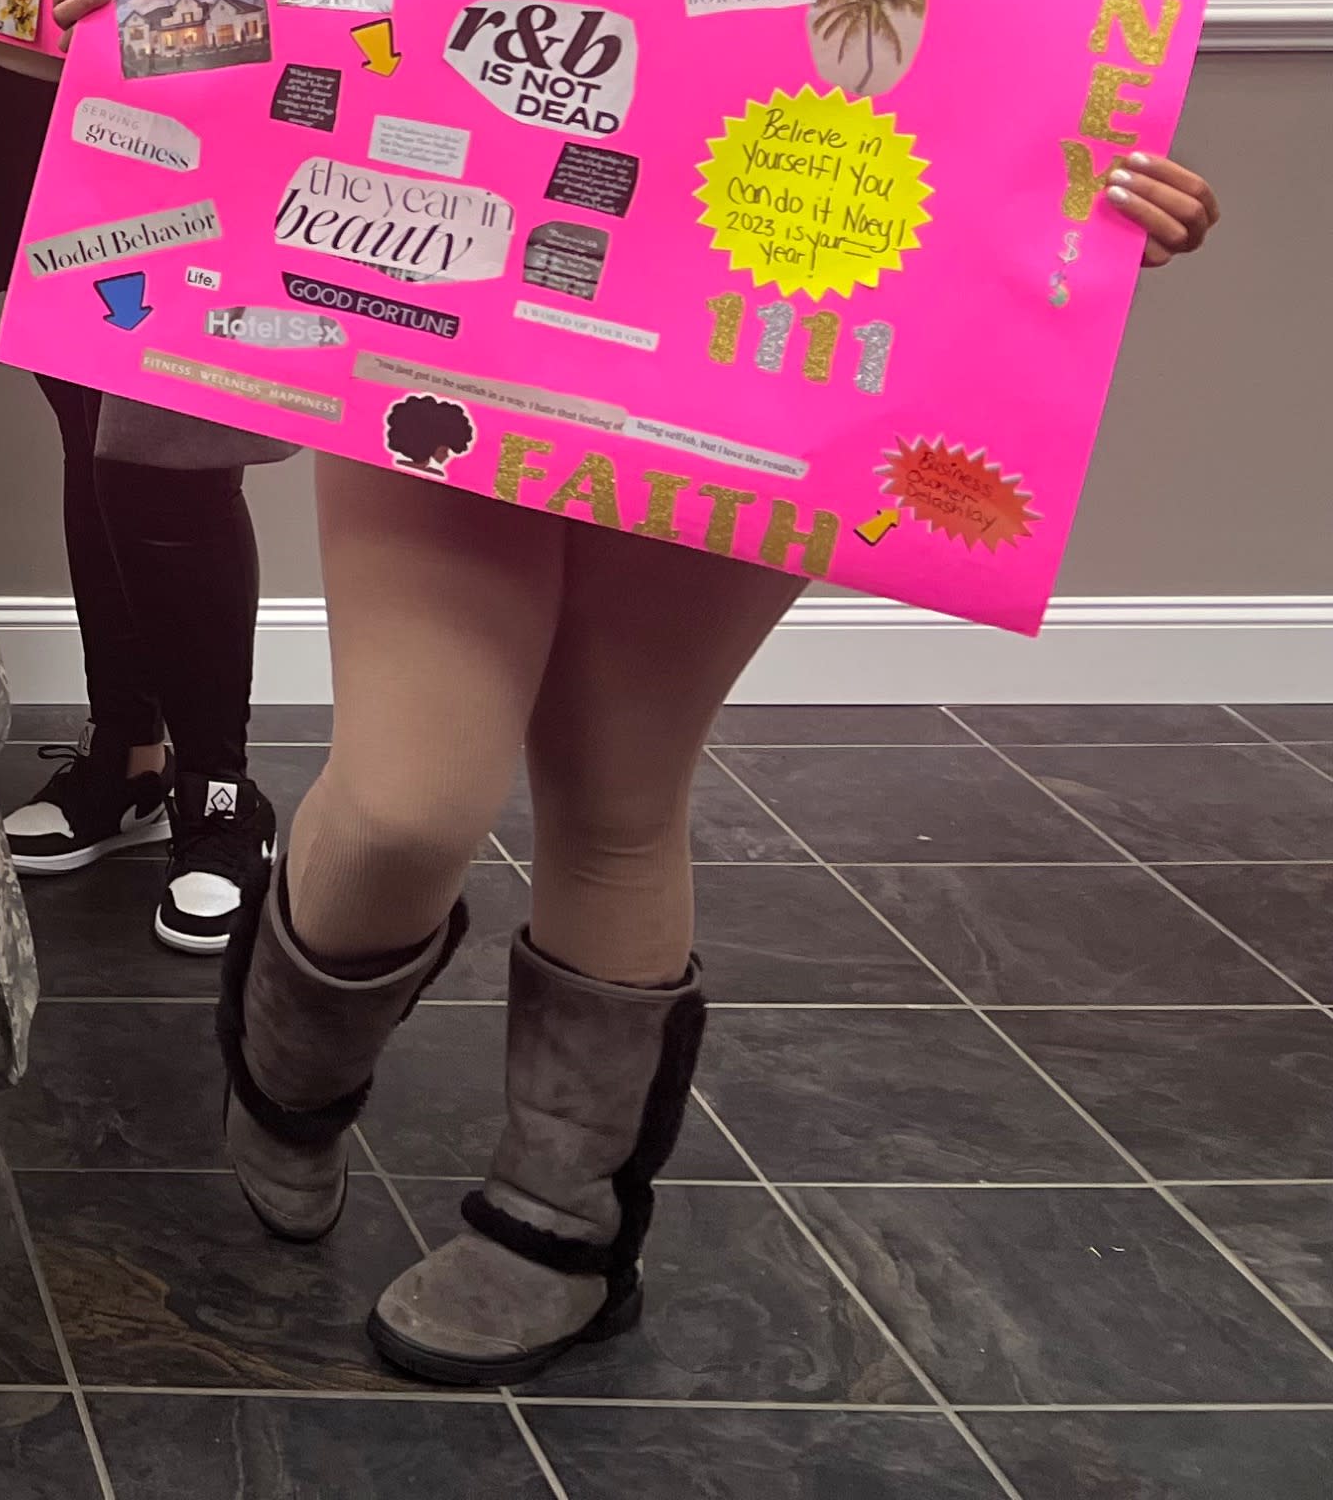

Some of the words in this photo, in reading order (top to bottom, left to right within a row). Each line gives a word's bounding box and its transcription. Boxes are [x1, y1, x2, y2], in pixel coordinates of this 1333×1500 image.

[449, 3, 623, 78] r&b
[480, 60, 512, 85] IS
[521, 70, 602, 102] NOT
[81, 103, 140, 131] SERVING
[514, 94, 620, 135] DEAD
[761, 108, 848, 148] Believe
[858, 133, 882, 157] in
[84, 121, 190, 170] greatness
[309, 160, 372, 202] the
[381, 181, 471, 221] year
[482, 192, 514, 231] in
[112, 211, 216, 255] Behavior
[275, 188, 473, 273] beauty
[32, 234, 109, 274] Model
[186, 269, 217, 289] Life,
[208, 310, 281, 340] Hotel
[287, 315, 342, 345] Sex
[288, 280, 353, 310] GOOD
[356, 297, 458, 337] FORTUNE
[492, 432, 841, 577] FAITH
